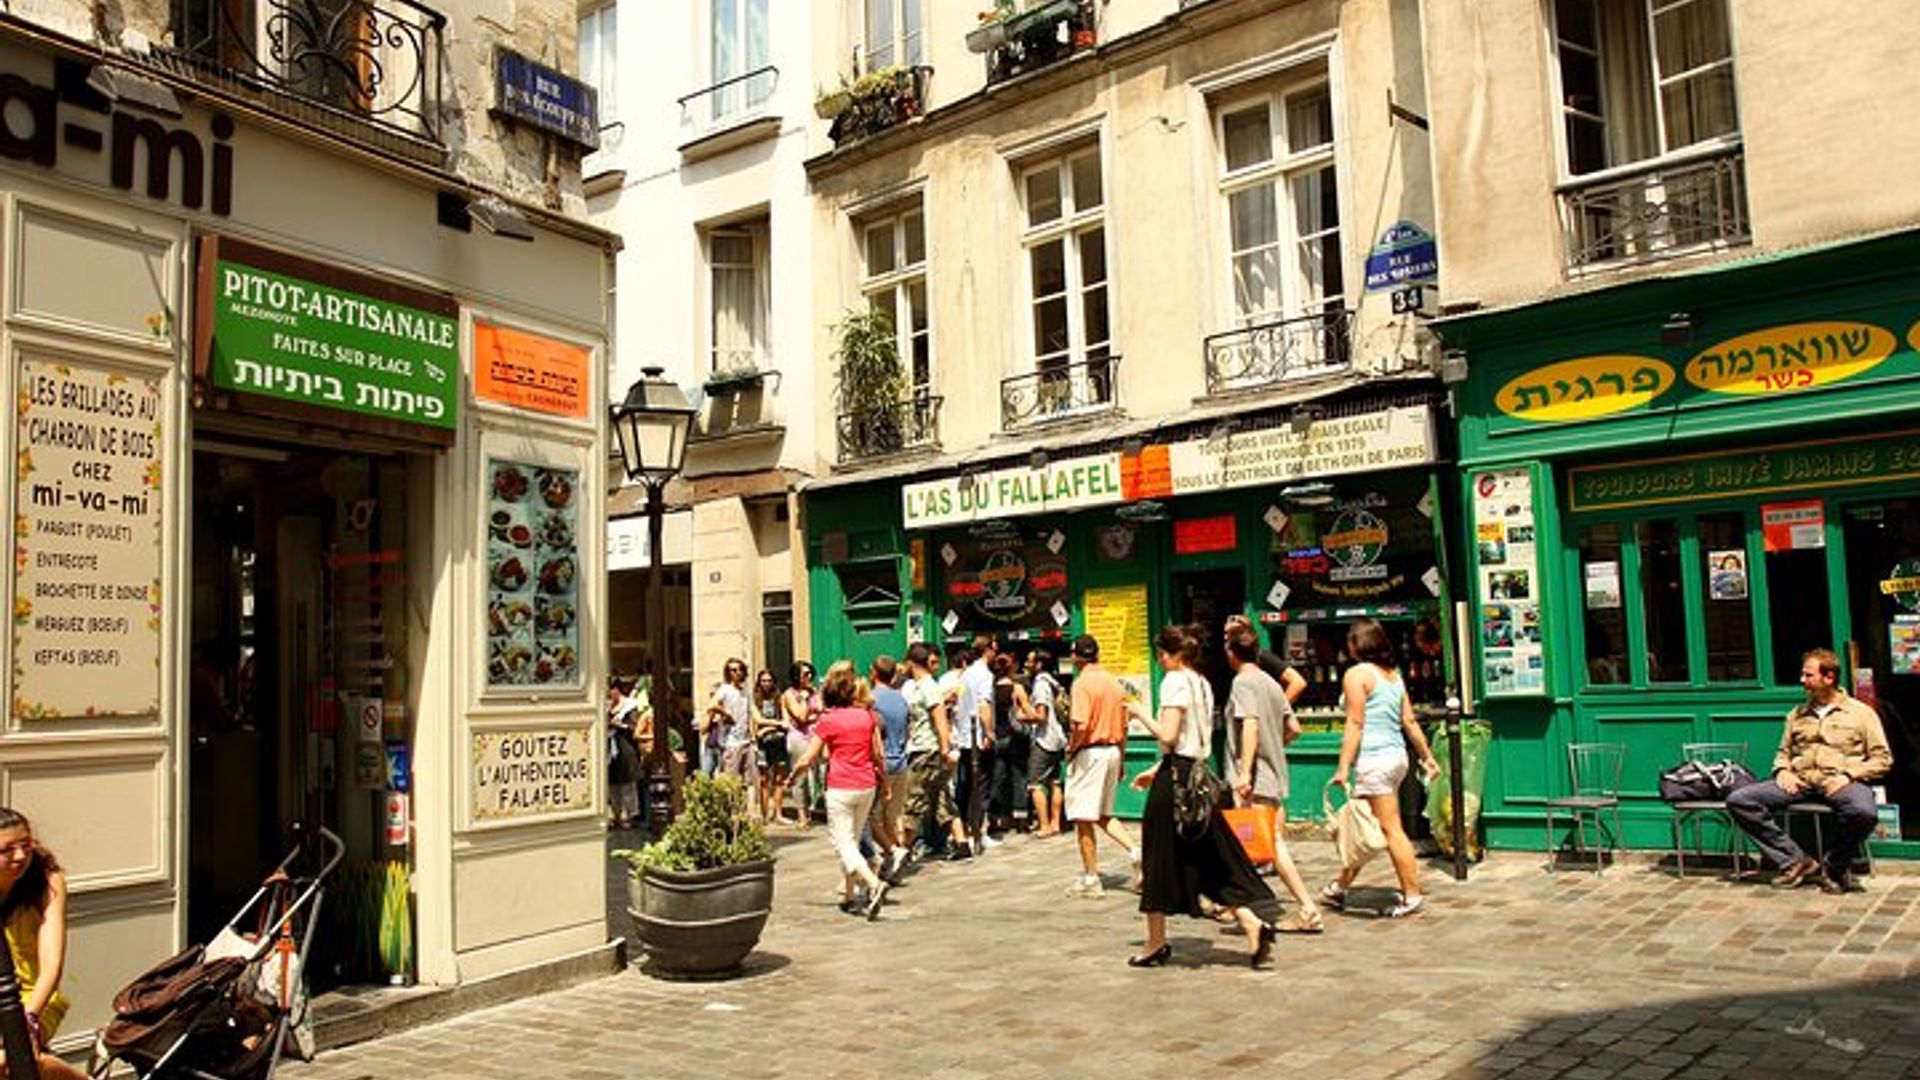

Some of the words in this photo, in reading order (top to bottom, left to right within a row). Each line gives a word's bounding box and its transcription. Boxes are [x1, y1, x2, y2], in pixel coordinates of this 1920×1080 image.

[223, 268, 455, 349] PITOT-ARTISANALE
[1395, 289, 1420, 312] 34
[272, 333, 330, 361] FAITES
[333, 345, 364, 366] SUR
[367, 352, 413, 378] PLACE
[1698, 327, 1872, 380] שווארמה
[29, 374, 56, 406] LES
[61, 380, 135, 419] GRILLADES
[139, 395, 157, 421] AU
[234, 358, 345, 402] ביתיות
[1513, 366, 1661, 412] פרגית
[1756, 368, 1814, 391] כשר
[356, 382, 445, 420] פיתות
[29, 416, 97, 452] CHARBON
[101, 426, 117, 456] DE
[121, 427, 154, 459] BOIS
[1315, 440, 1333, 455] EN
[72, 461, 112, 482] CHEZ
[1205, 471, 1220, 486] LE
[1367, 449, 1385, 464] DE
[1387, 442, 1425, 461] PARIS
[32, 479, 149, 516] mi-va-mi
[906, 485, 951, 520] L'AS
[959, 479, 988, 512] DU
[999, 463, 1118, 507] FALLAFEL
[35, 582, 97, 600] BROCHETTE
[100, 585, 114, 600] DE
[34, 615, 85, 632] MERGUEZ
[34, 648, 76, 666] KEFTAS
[500, 735, 568, 760] GOUTEZ
[478, 758, 587, 787] L'AUTHENTIQUE
[499, 783, 571, 810] FALAFEL
